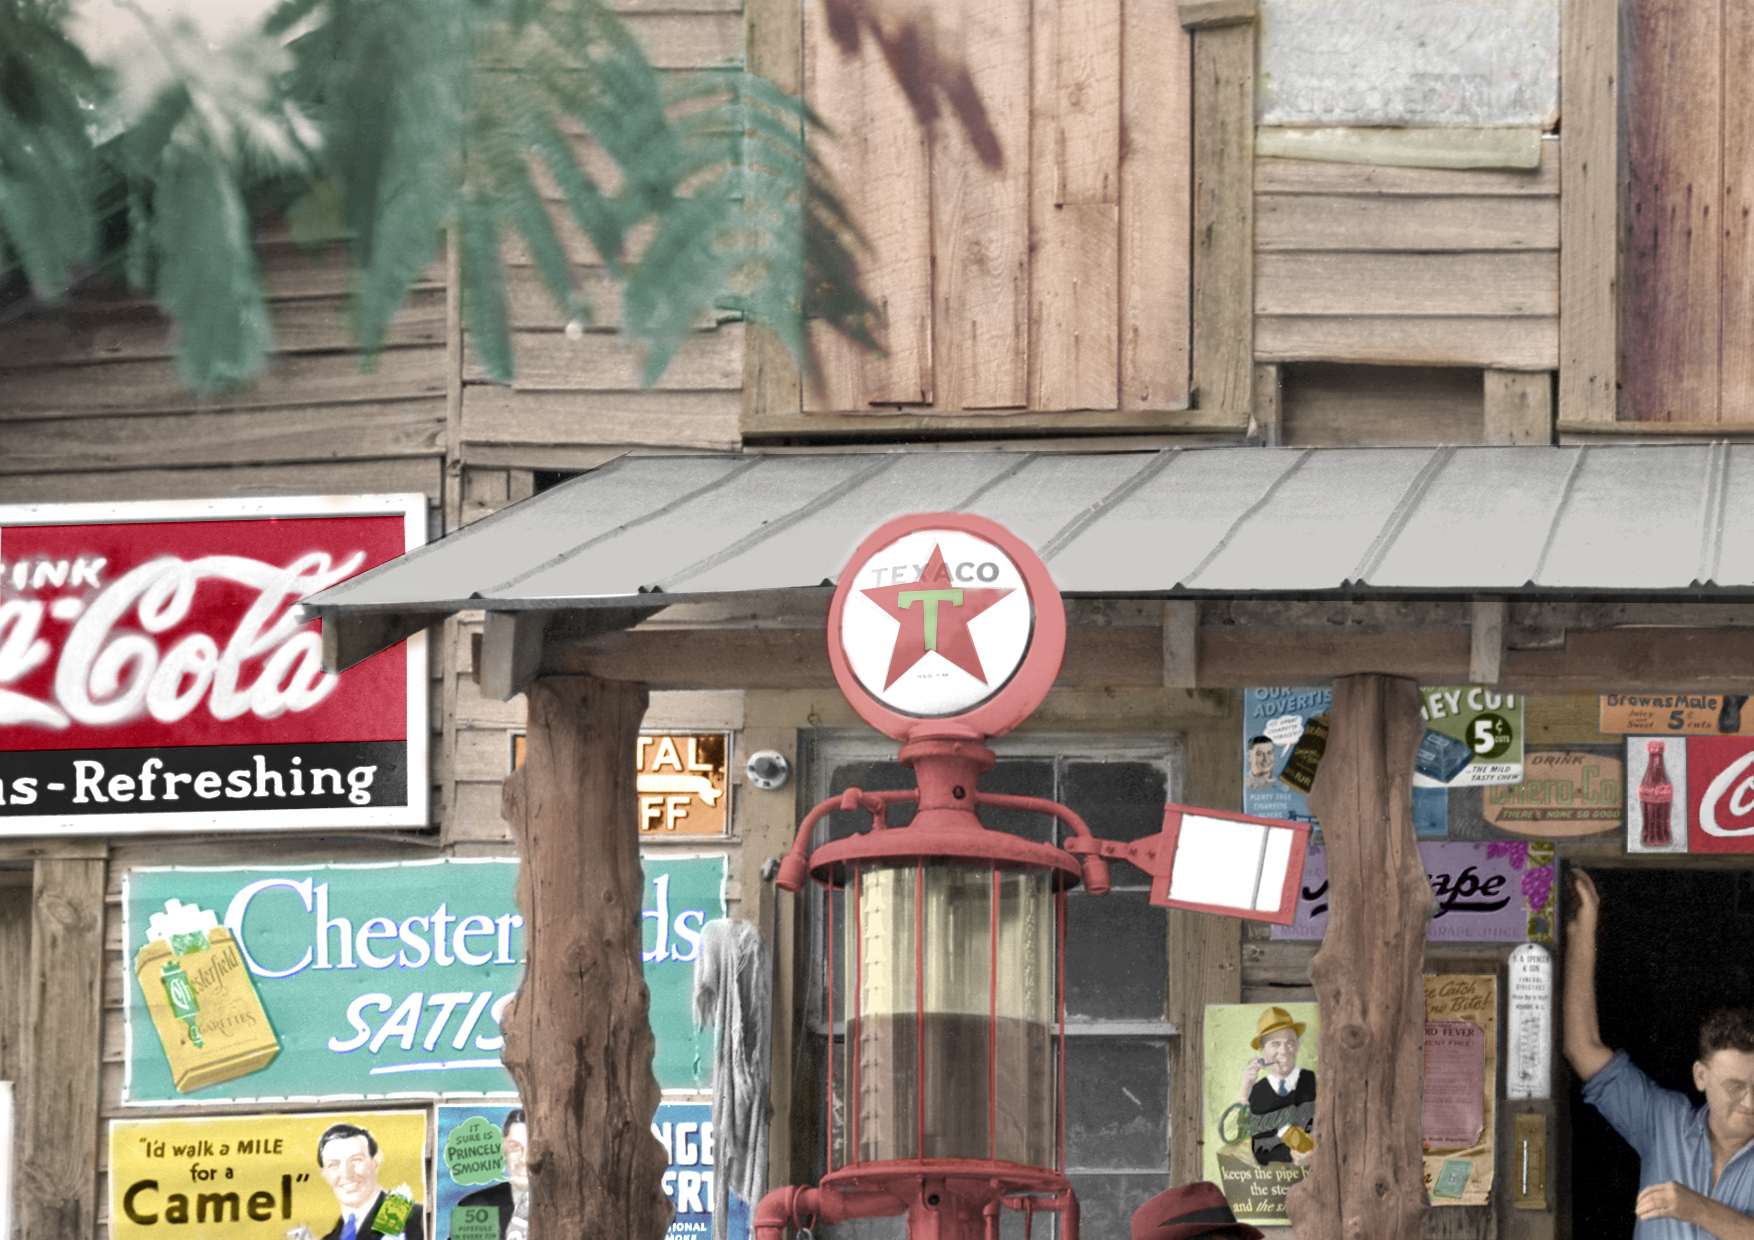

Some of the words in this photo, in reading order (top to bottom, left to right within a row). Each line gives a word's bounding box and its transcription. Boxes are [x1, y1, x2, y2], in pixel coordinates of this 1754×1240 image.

[871, 562, 1000, 588] TEXACO
[1253, 690, 1333, 718] ADVERTIS
[1687, 718, 1711, 729] cuts
[637, 736, 713, 772] TAL
[1531, 755, 1585, 766] DRINK
[1491, 765, 1511, 773] MILD
[0, 755, 377, 806] s-Refreshing
[1471, 774, 1494, 782] TASTY
[1577, 810, 1589, 819] SO
[1592, 810, 1620, 819] GOOD
[1439, 980, 1477, 998] Catch
[1430, 1004, 1447, 1013] no
[1450, 991, 1491, 1012] Bite!
[328, 991, 518, 1053] SATIS
[1443, 1028, 1475, 1037] FEVER
[469, 1123, 481, 1133] IT
[455, 1132, 480, 1146] SURE
[483, 1131, 493, 1141] IS
[172, 1139, 214, 1158] walk
[219, 1144, 230, 1156] a
[237, 1138, 283, 1155] MILE
[447, 1143, 502, 1162] PRINCELY
[189, 1162, 217, 1183] for
[224, 1167, 234, 1180] a
[451, 1156, 503, 1176] SMOKIN'
[1221, 1166, 1251, 1182] keeps
[1254, 1166, 1271, 1180] the
[1276, 1168, 1300, 1182] pipe
[1250, 1183, 1268, 1196] the
[1233, 1199, 1252, 1212] and
[1255, 1199, 1275, 1212] the
[464, 1208, 489, 1224] 50
[667, 1222, 707, 1232] IONAL
